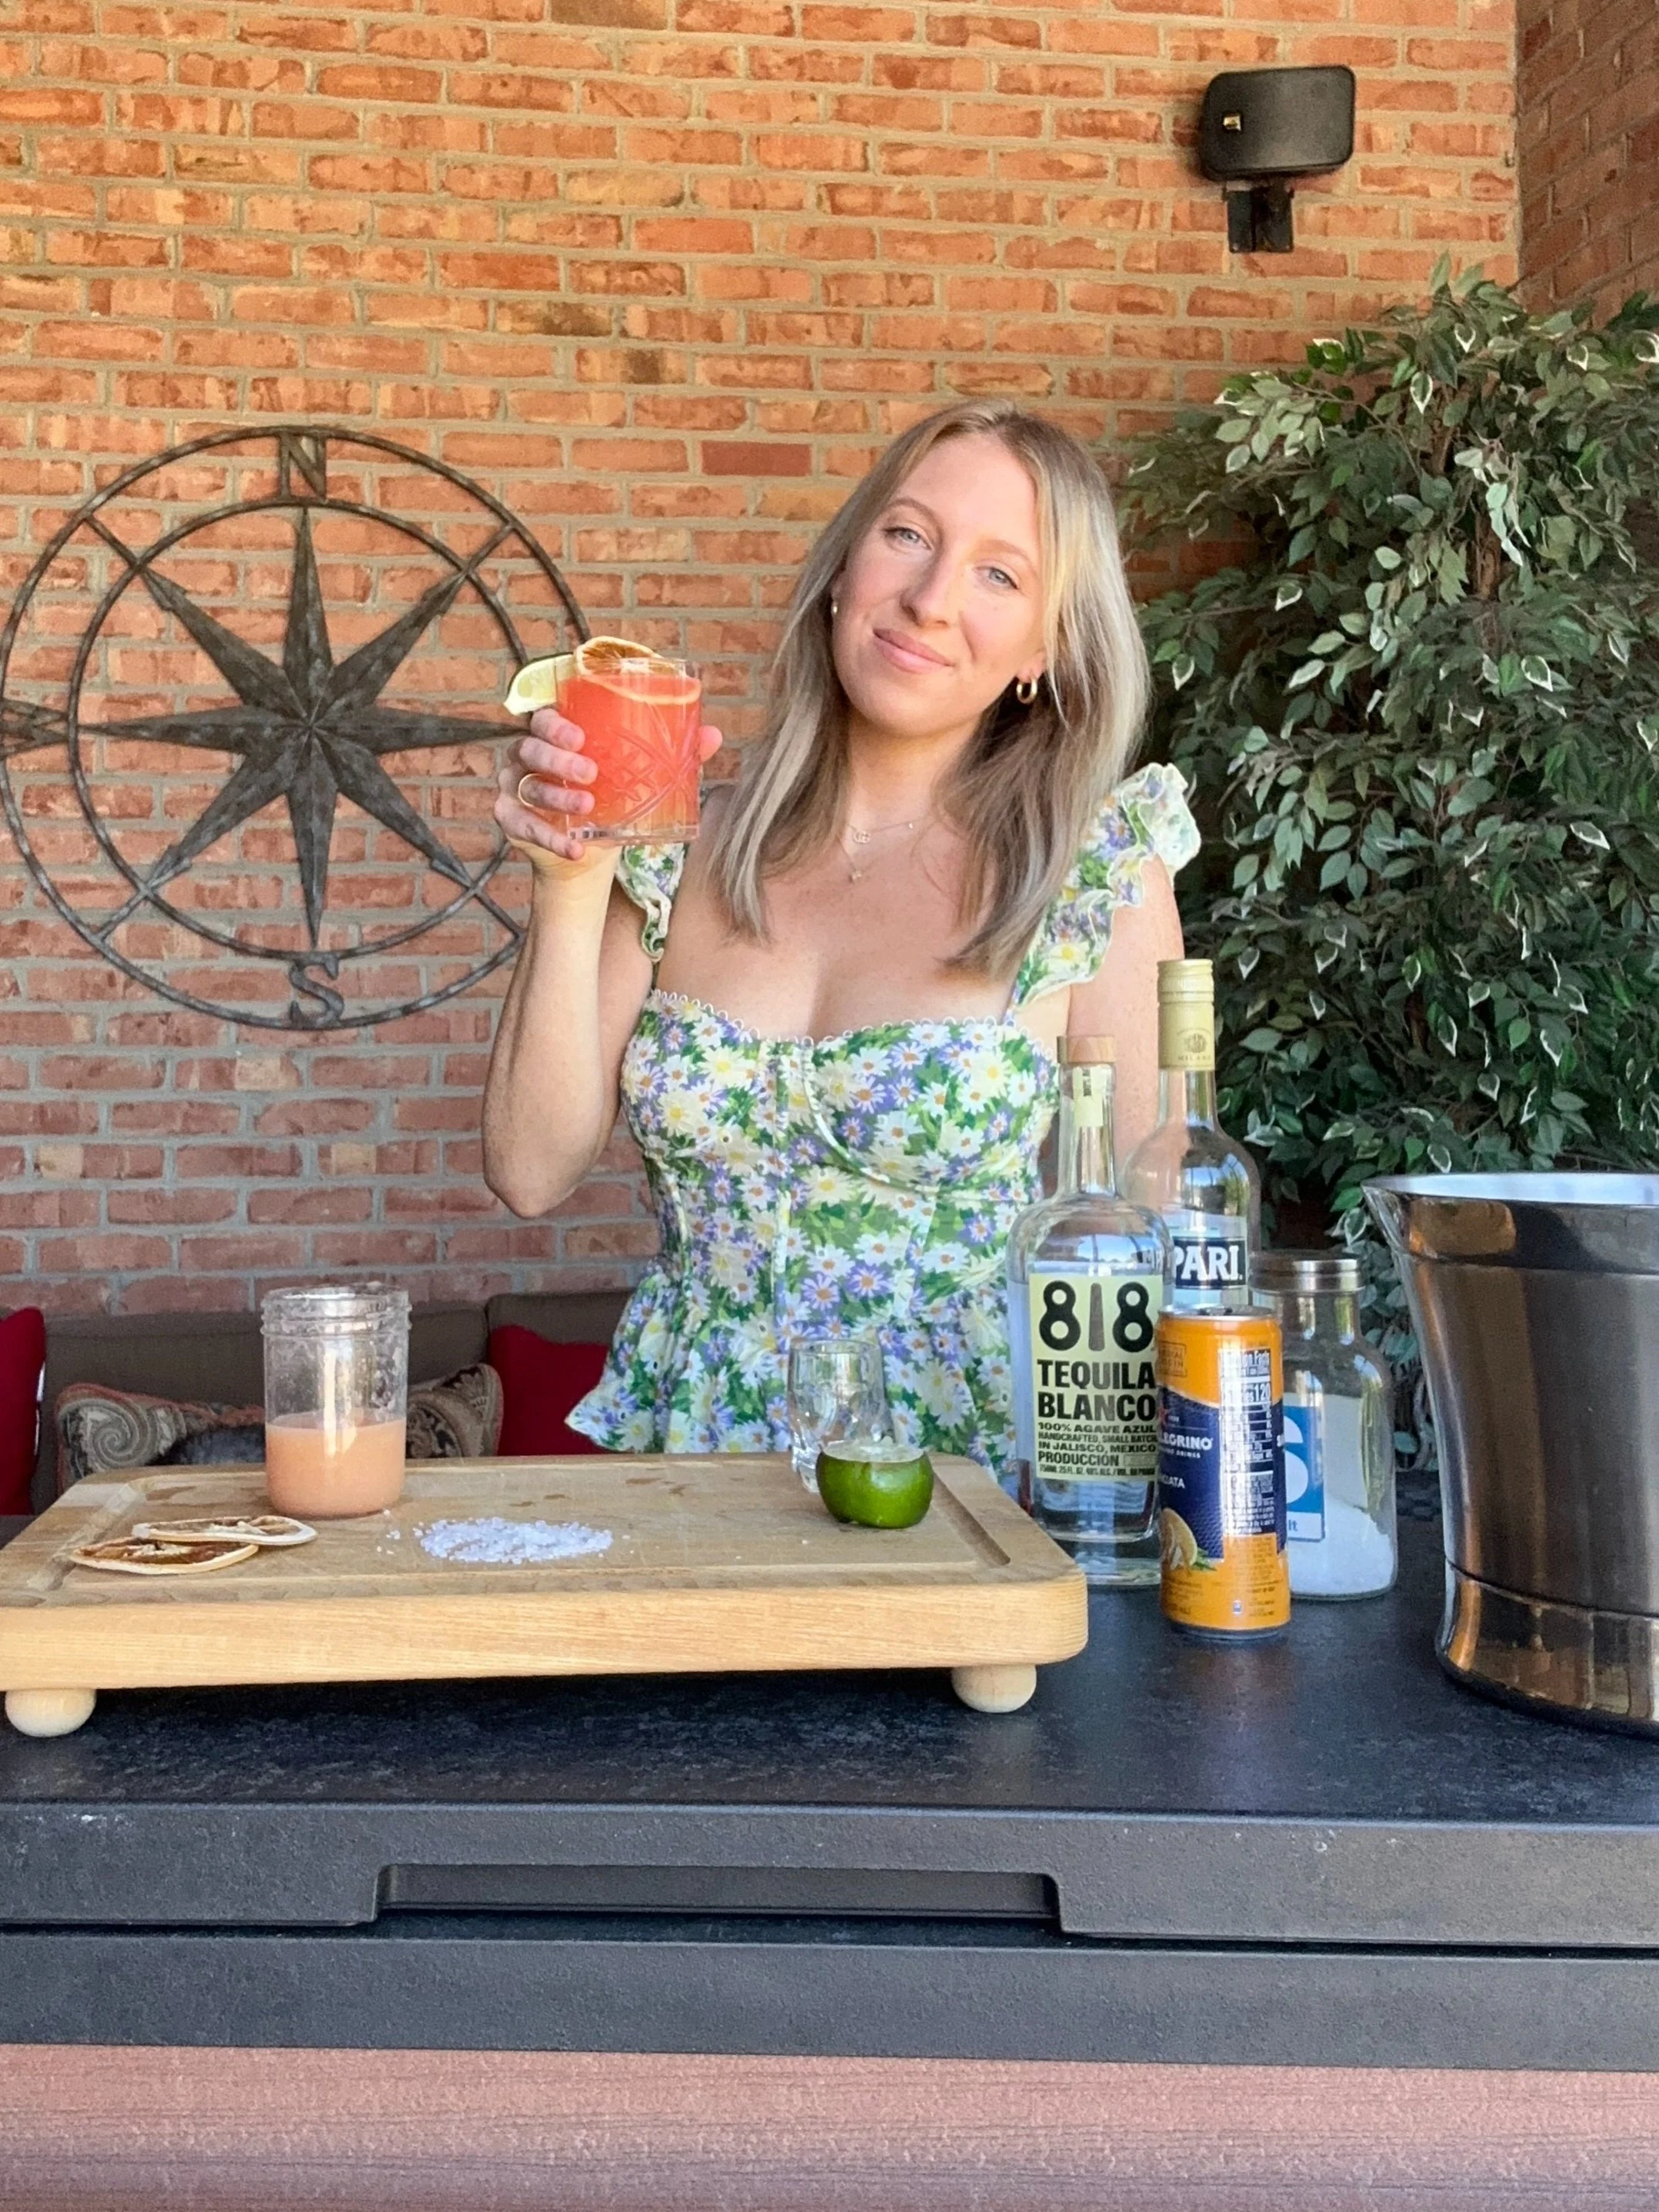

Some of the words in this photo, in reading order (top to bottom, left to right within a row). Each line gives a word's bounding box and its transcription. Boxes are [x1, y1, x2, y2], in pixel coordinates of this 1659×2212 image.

[278, 429, 327, 504] N
[288, 953, 345, 1029] S
[1039, 1280, 1154, 1353] 818
[1037, 1358, 1156, 1390] TEQUILA
[1038, 1391, 1156, 1421] BLANCO
[1038, 1421, 1071, 1431] 100%
[1074, 1424, 1120, 1434] AGAVE
[1123, 1424, 1157, 1434] AZUL
[1038, 1441, 1051, 1450] IN
[1110, 1444, 1156, 1453] MEXICO
